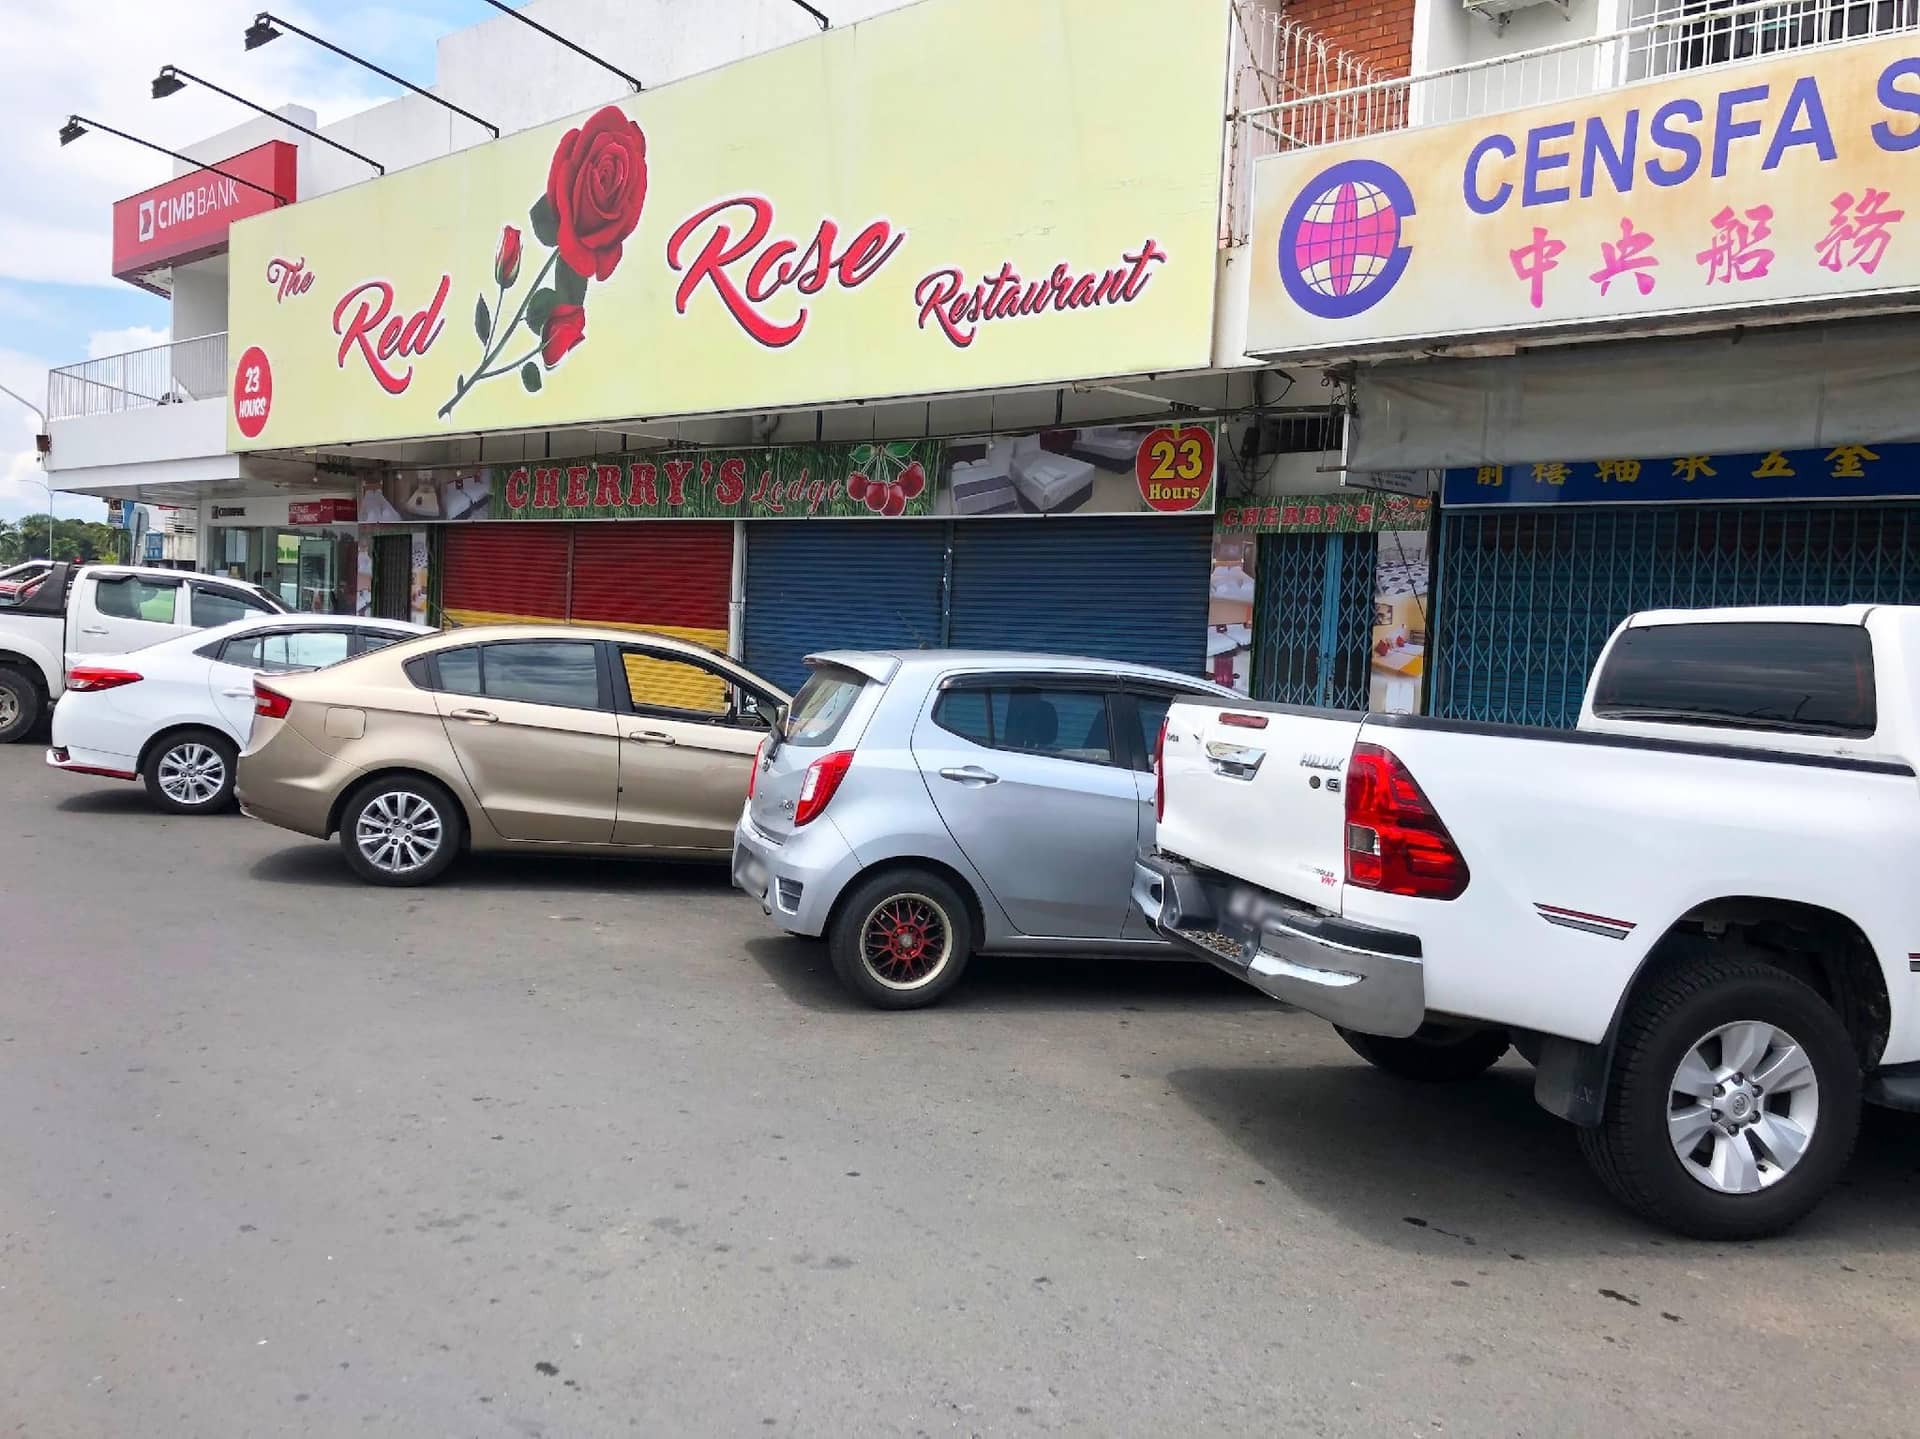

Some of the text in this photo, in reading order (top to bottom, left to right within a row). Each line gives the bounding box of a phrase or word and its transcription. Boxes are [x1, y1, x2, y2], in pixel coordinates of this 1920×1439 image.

[1463, 75, 1838, 216] CENSFA
[158, 174, 240, 229] CIMB BANK
[1509, 187, 1905, 309] 中央船務
[266, 196, 1168, 395] The Red Rose Restaurant
[244, 366, 261, 394] 23
[238, 399, 268, 419] HOURS
[1149, 439, 1203, 480] 23
[505, 457, 842, 515] CHERRY'S Lodge
[1148, 482, 1200, 500] Hours
[1221, 503, 1374, 527] CHERRY'S
[1299, 751, 1345, 772] HILUX
